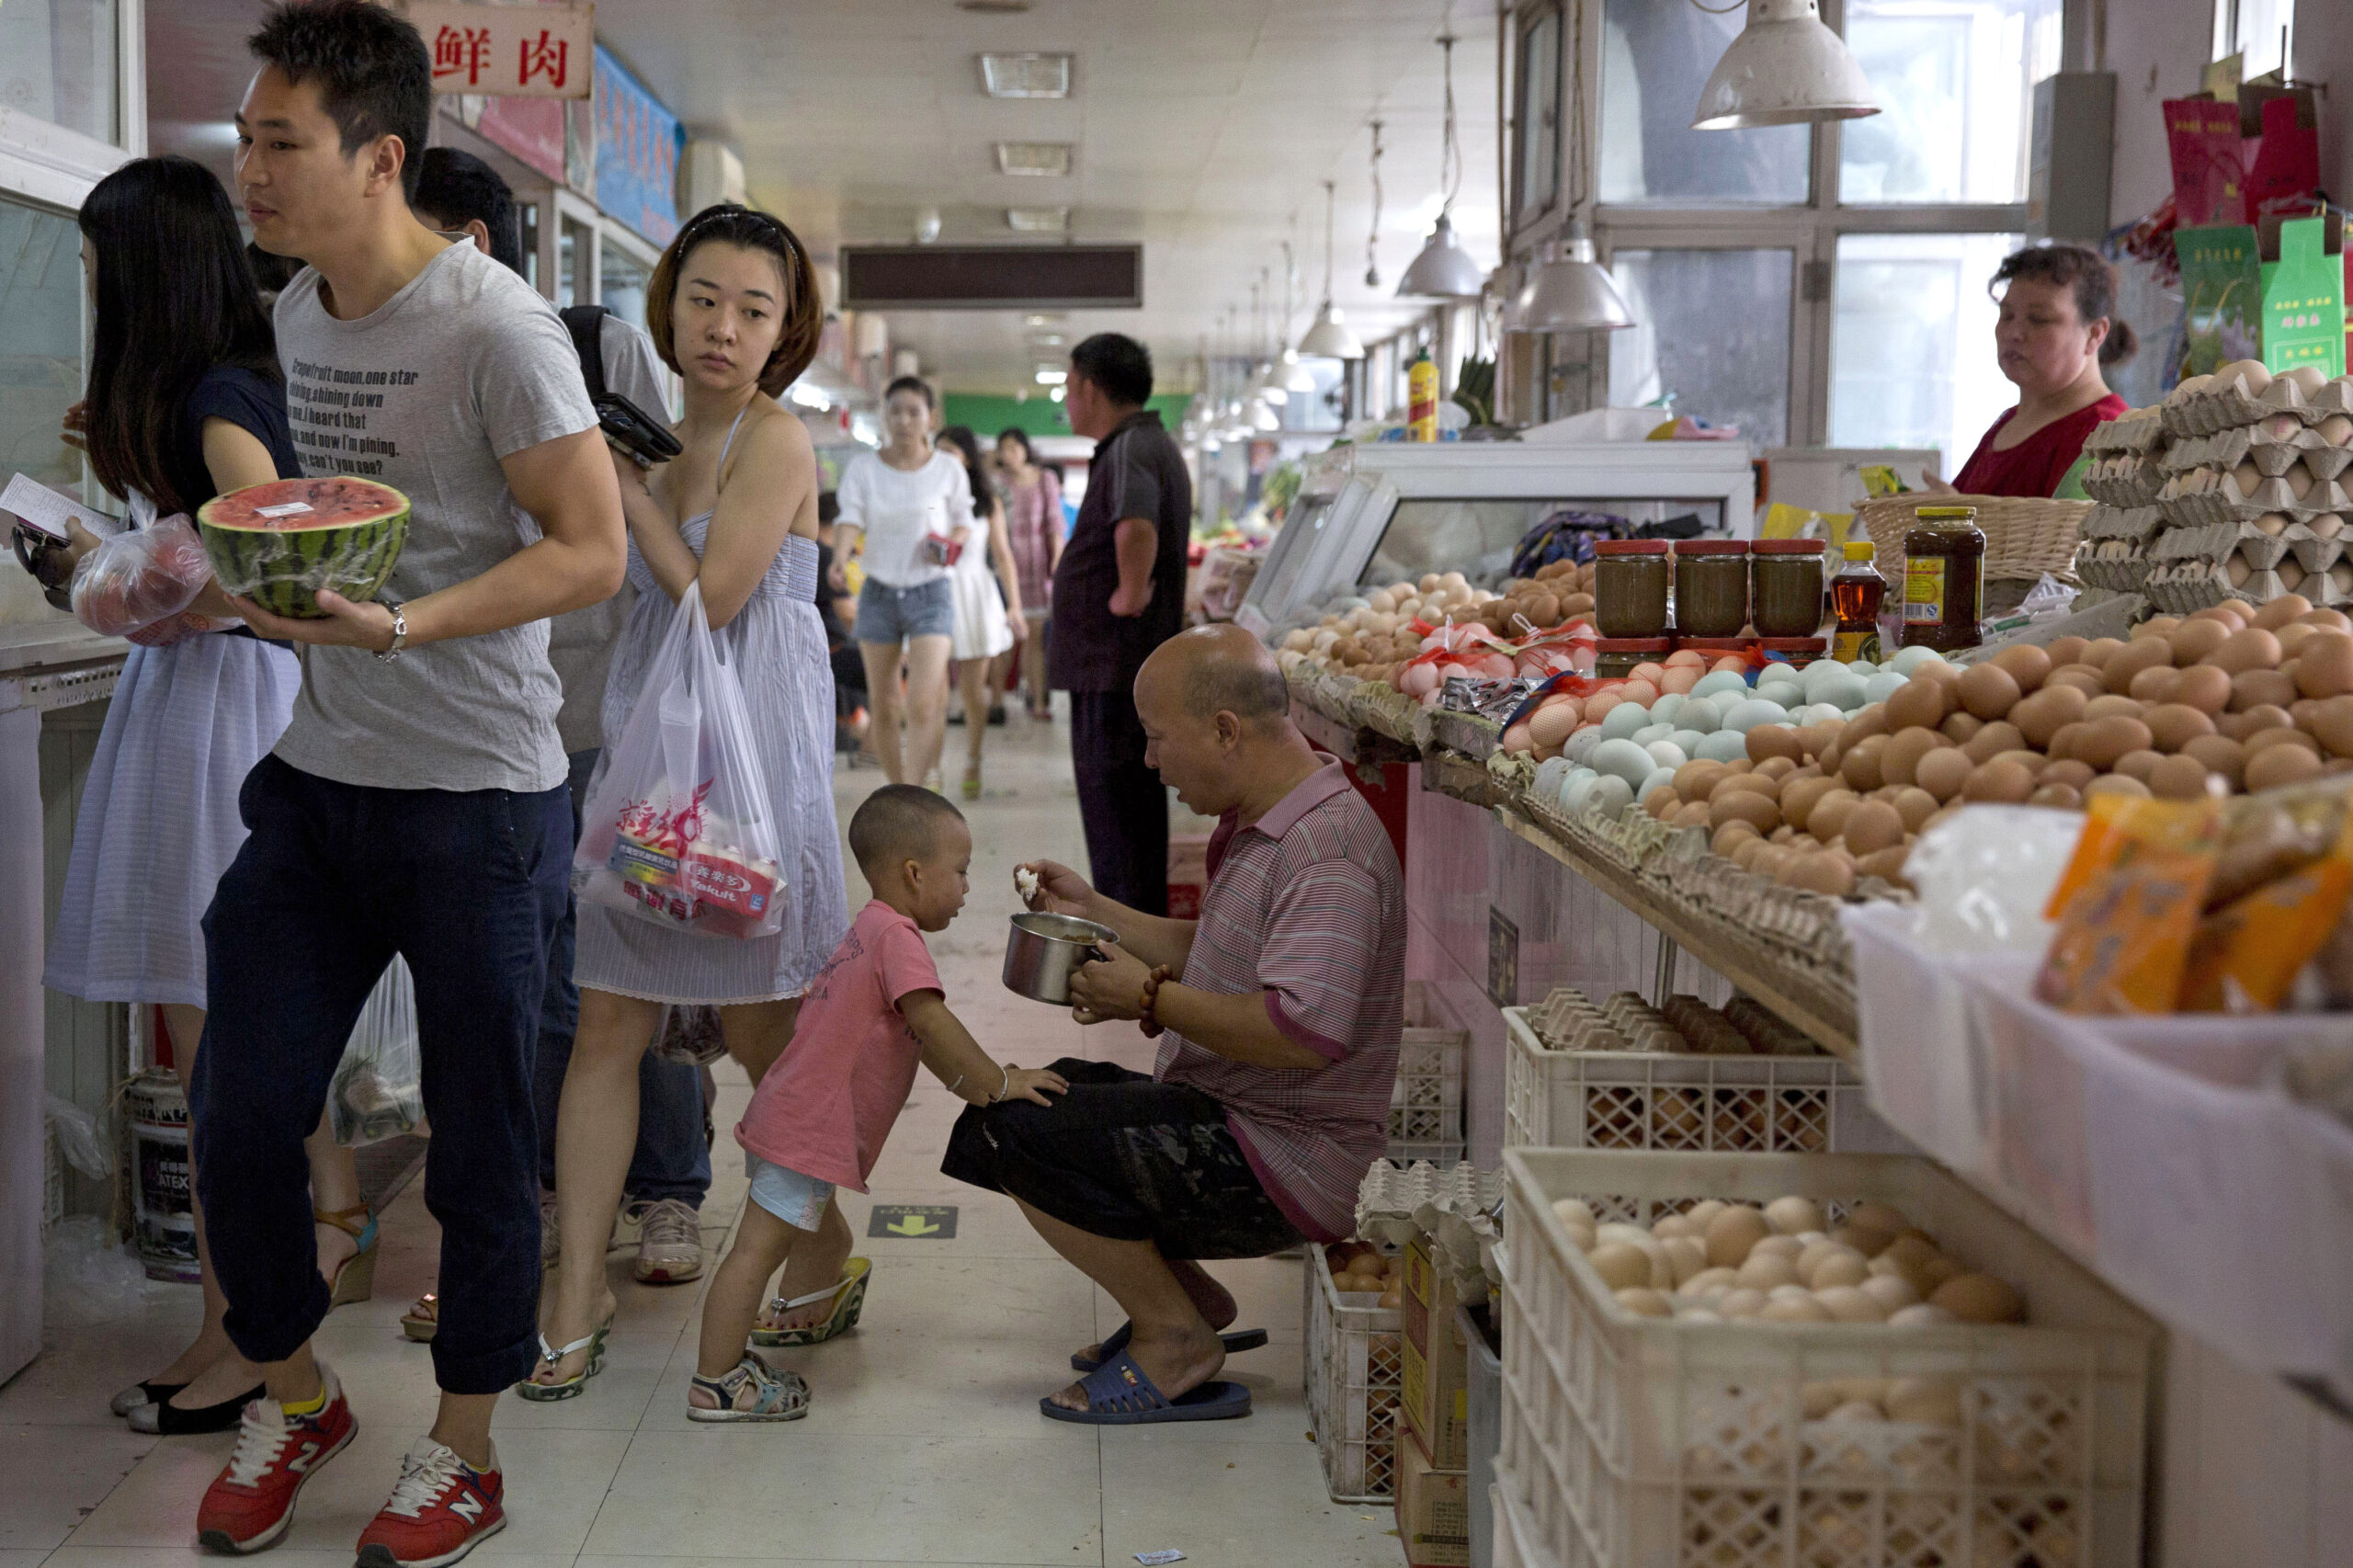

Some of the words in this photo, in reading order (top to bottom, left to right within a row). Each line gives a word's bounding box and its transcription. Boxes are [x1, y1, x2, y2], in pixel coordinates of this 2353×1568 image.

[433, 25, 568, 88] 鲜肉
[390, 369, 419, 386] star
[352, 391, 383, 408] down
[310, 407, 341, 427] heard
[343, 412, 367, 429] that
[319, 433, 340, 449] now
[343, 433, 358, 452] I'm
[335, 458, 355, 473] you
[357, 460, 383, 475] see?
[690, 880, 736, 903] Yakult
[449, 1490, 484, 1526] N
